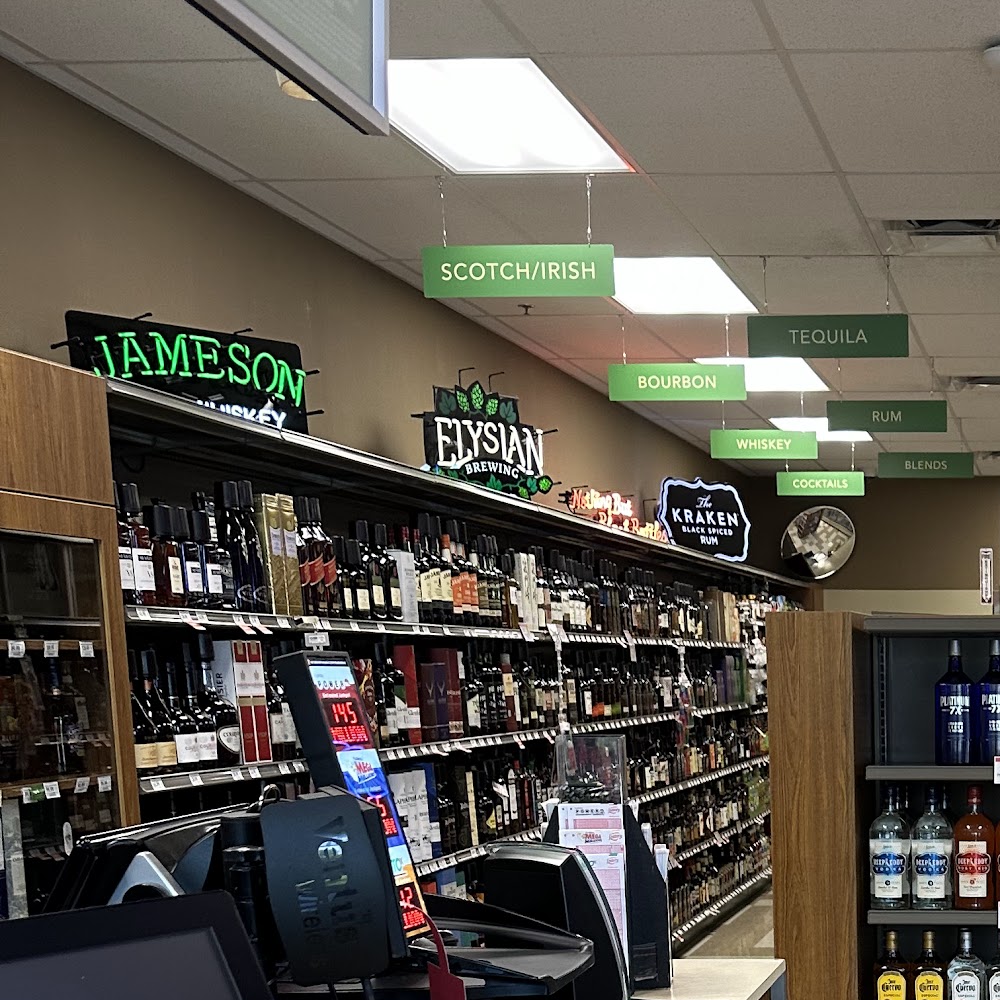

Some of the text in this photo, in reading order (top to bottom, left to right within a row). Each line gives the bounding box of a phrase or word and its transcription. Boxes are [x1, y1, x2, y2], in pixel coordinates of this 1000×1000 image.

[440, 261, 596, 281] SCOTCH/IRISH
[789, 328, 868, 346] TEQUILA
[94, 332, 306, 407] JAMESON
[638, 374, 717, 389] BOURBON
[871, 410, 902, 423] RUM
[434, 417, 544, 478] ELYSIAN
[736, 437, 792, 452] WHISKEY
[465, 462, 520, 479] BREWING
[904, 460, 948, 471] BLENDS
[792, 478, 849, 489] COCKTAILS
[696, 494, 712, 508] The
[672, 507, 739, 526] KRAKEN
[682, 526, 733, 536] BLACK SPICED
[700, 536, 718, 546] RUM
[332, 702, 358, 724] 145
[882, 983, 901, 992] Cuervo
[919, 983, 939, 992] Cuervo
[956, 984, 976, 992] Cuervo
